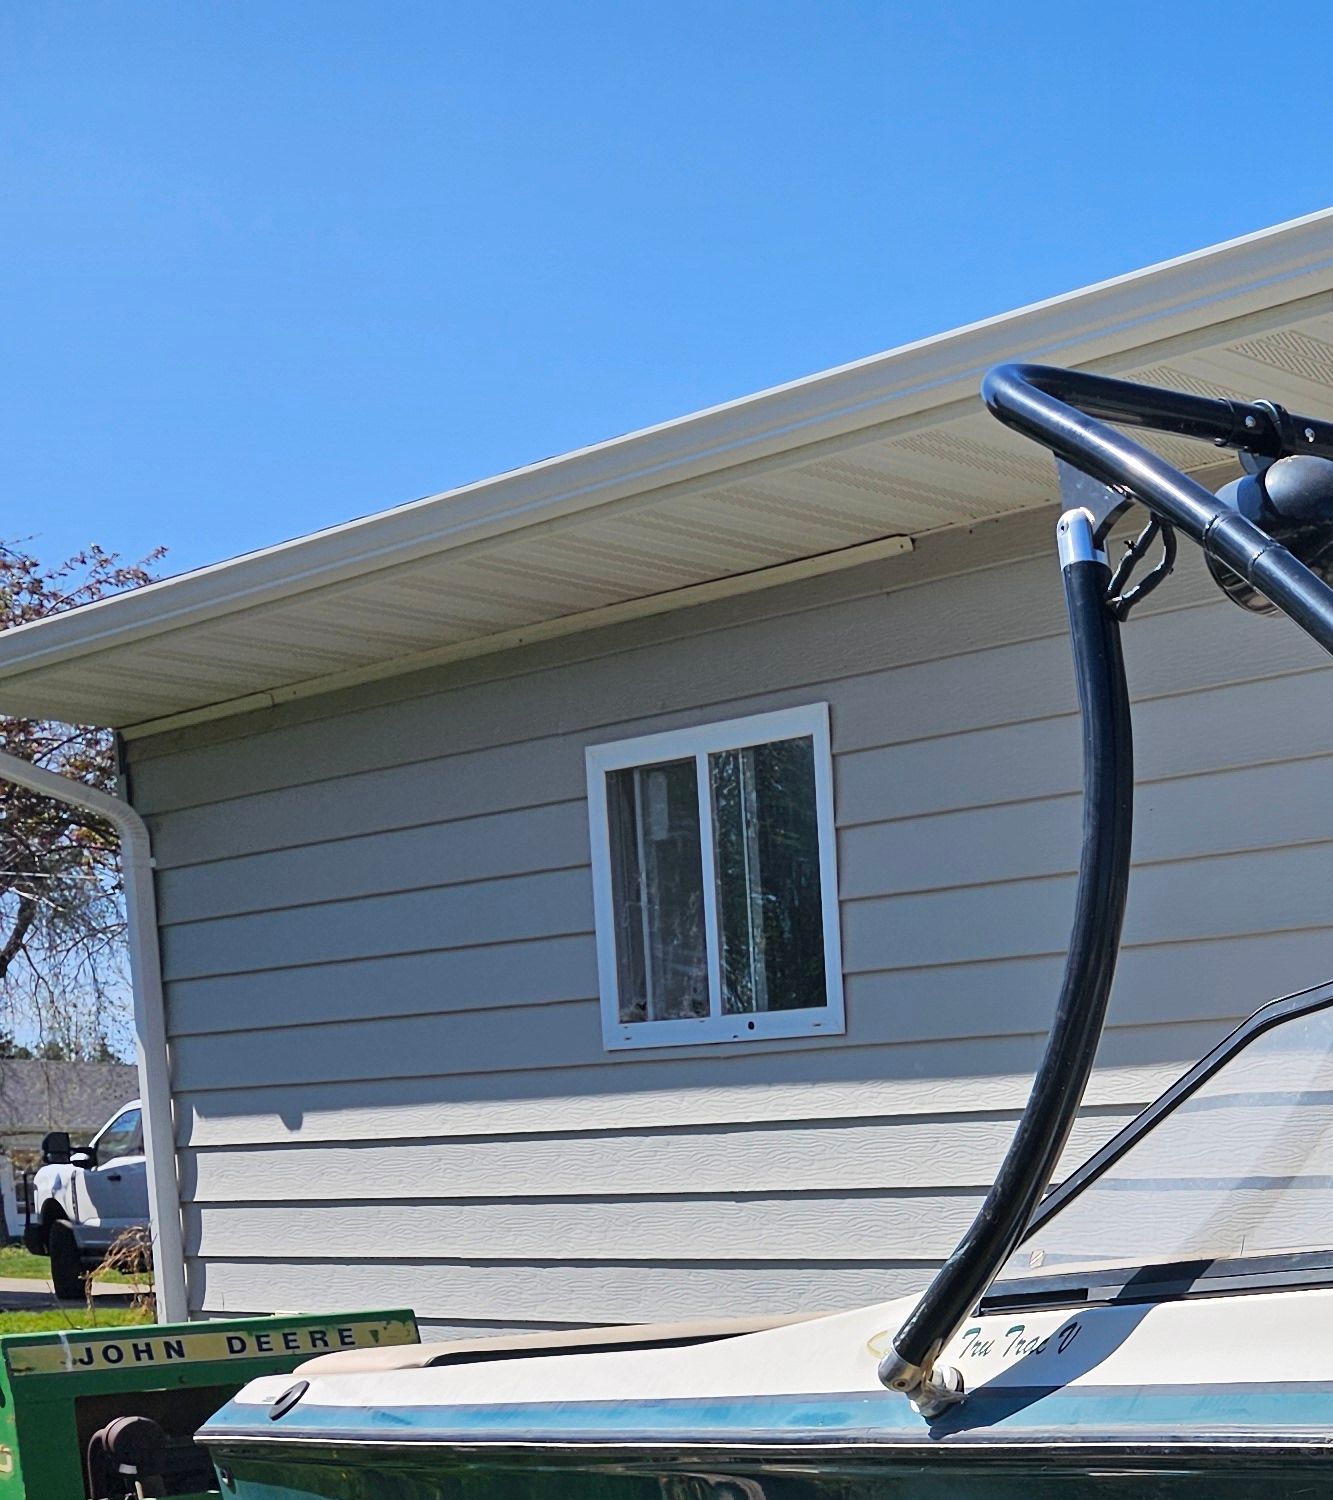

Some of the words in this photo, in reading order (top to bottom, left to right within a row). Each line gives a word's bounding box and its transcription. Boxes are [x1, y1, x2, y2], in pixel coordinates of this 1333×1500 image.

[78, 1339, 186, 1366] JOHN
[226, 1327, 357, 1355] DEERE
[958, 1327, 996, 1359] Tru
[1002, 1324, 1050, 1357] Trac
[1057, 1321, 1082, 1355] V
